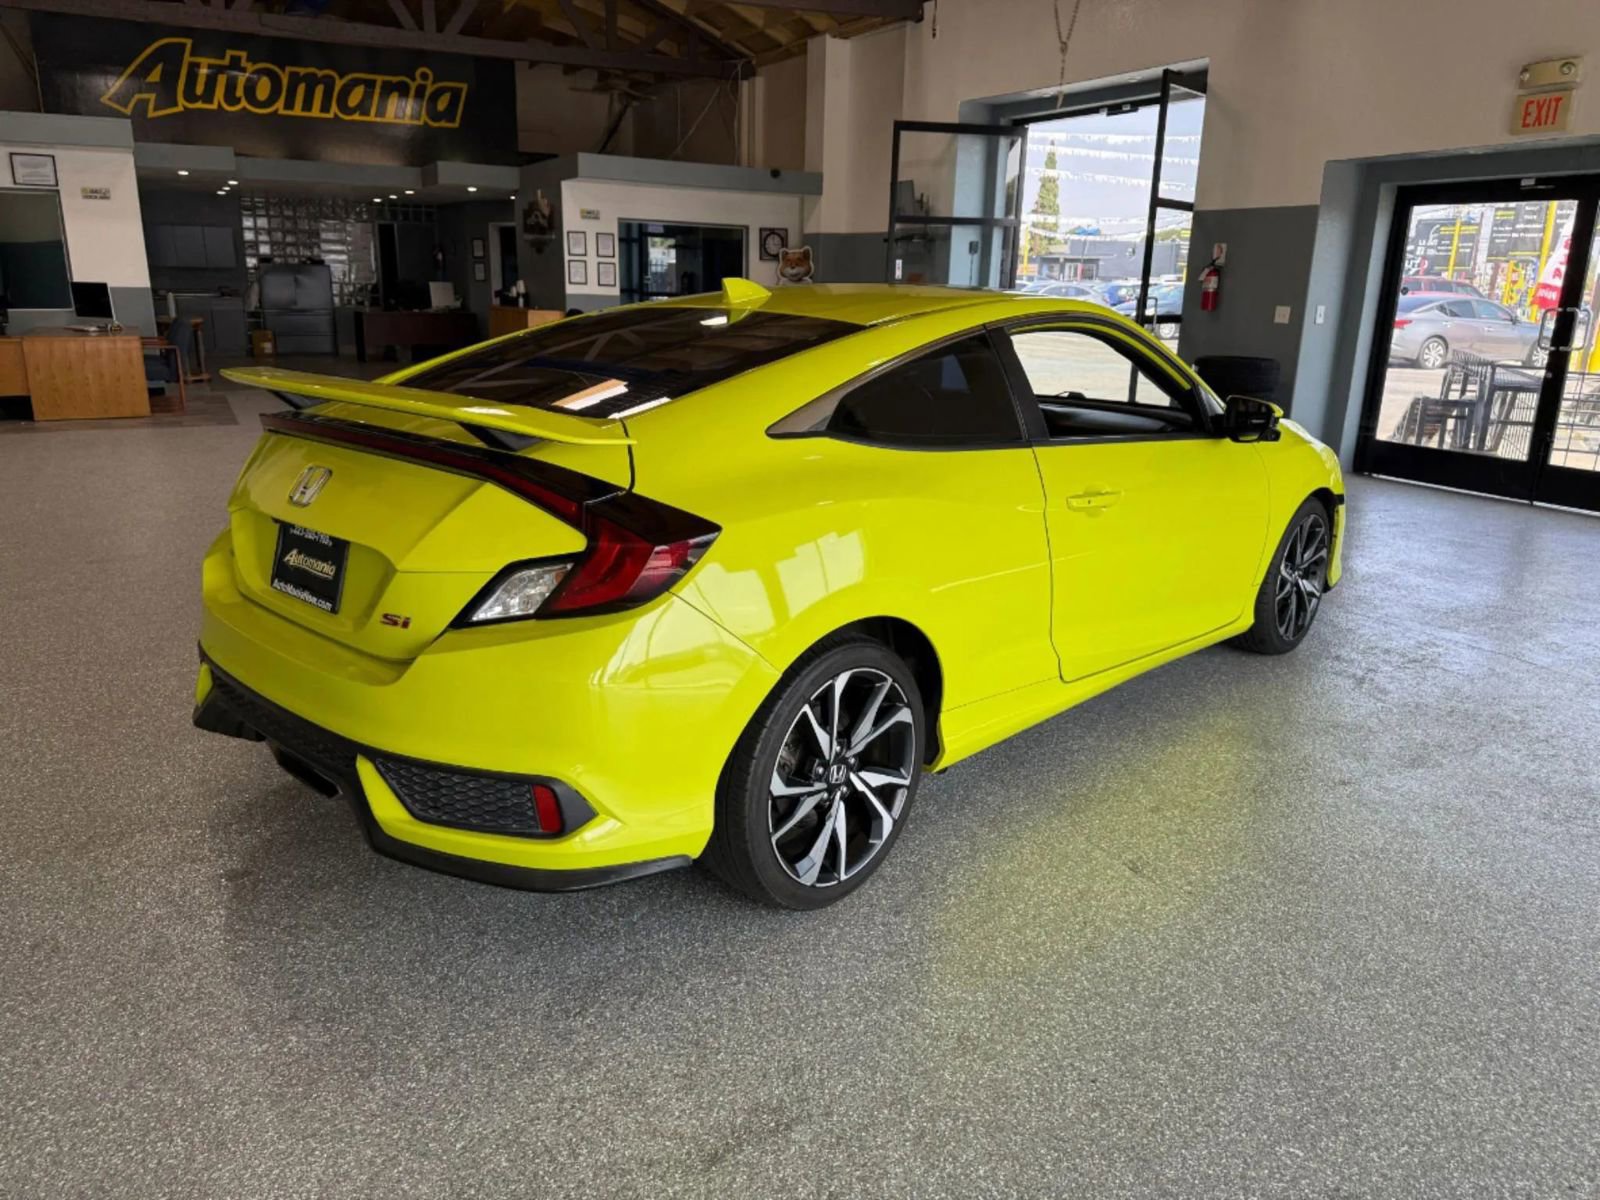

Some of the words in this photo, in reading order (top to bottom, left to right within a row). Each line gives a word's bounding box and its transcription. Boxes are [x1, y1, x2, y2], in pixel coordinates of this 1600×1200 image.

[100, 37, 468, 128] Automania
[1521, 95, 1563, 128] EXIT
[283, 548, 336, 577] Automania
